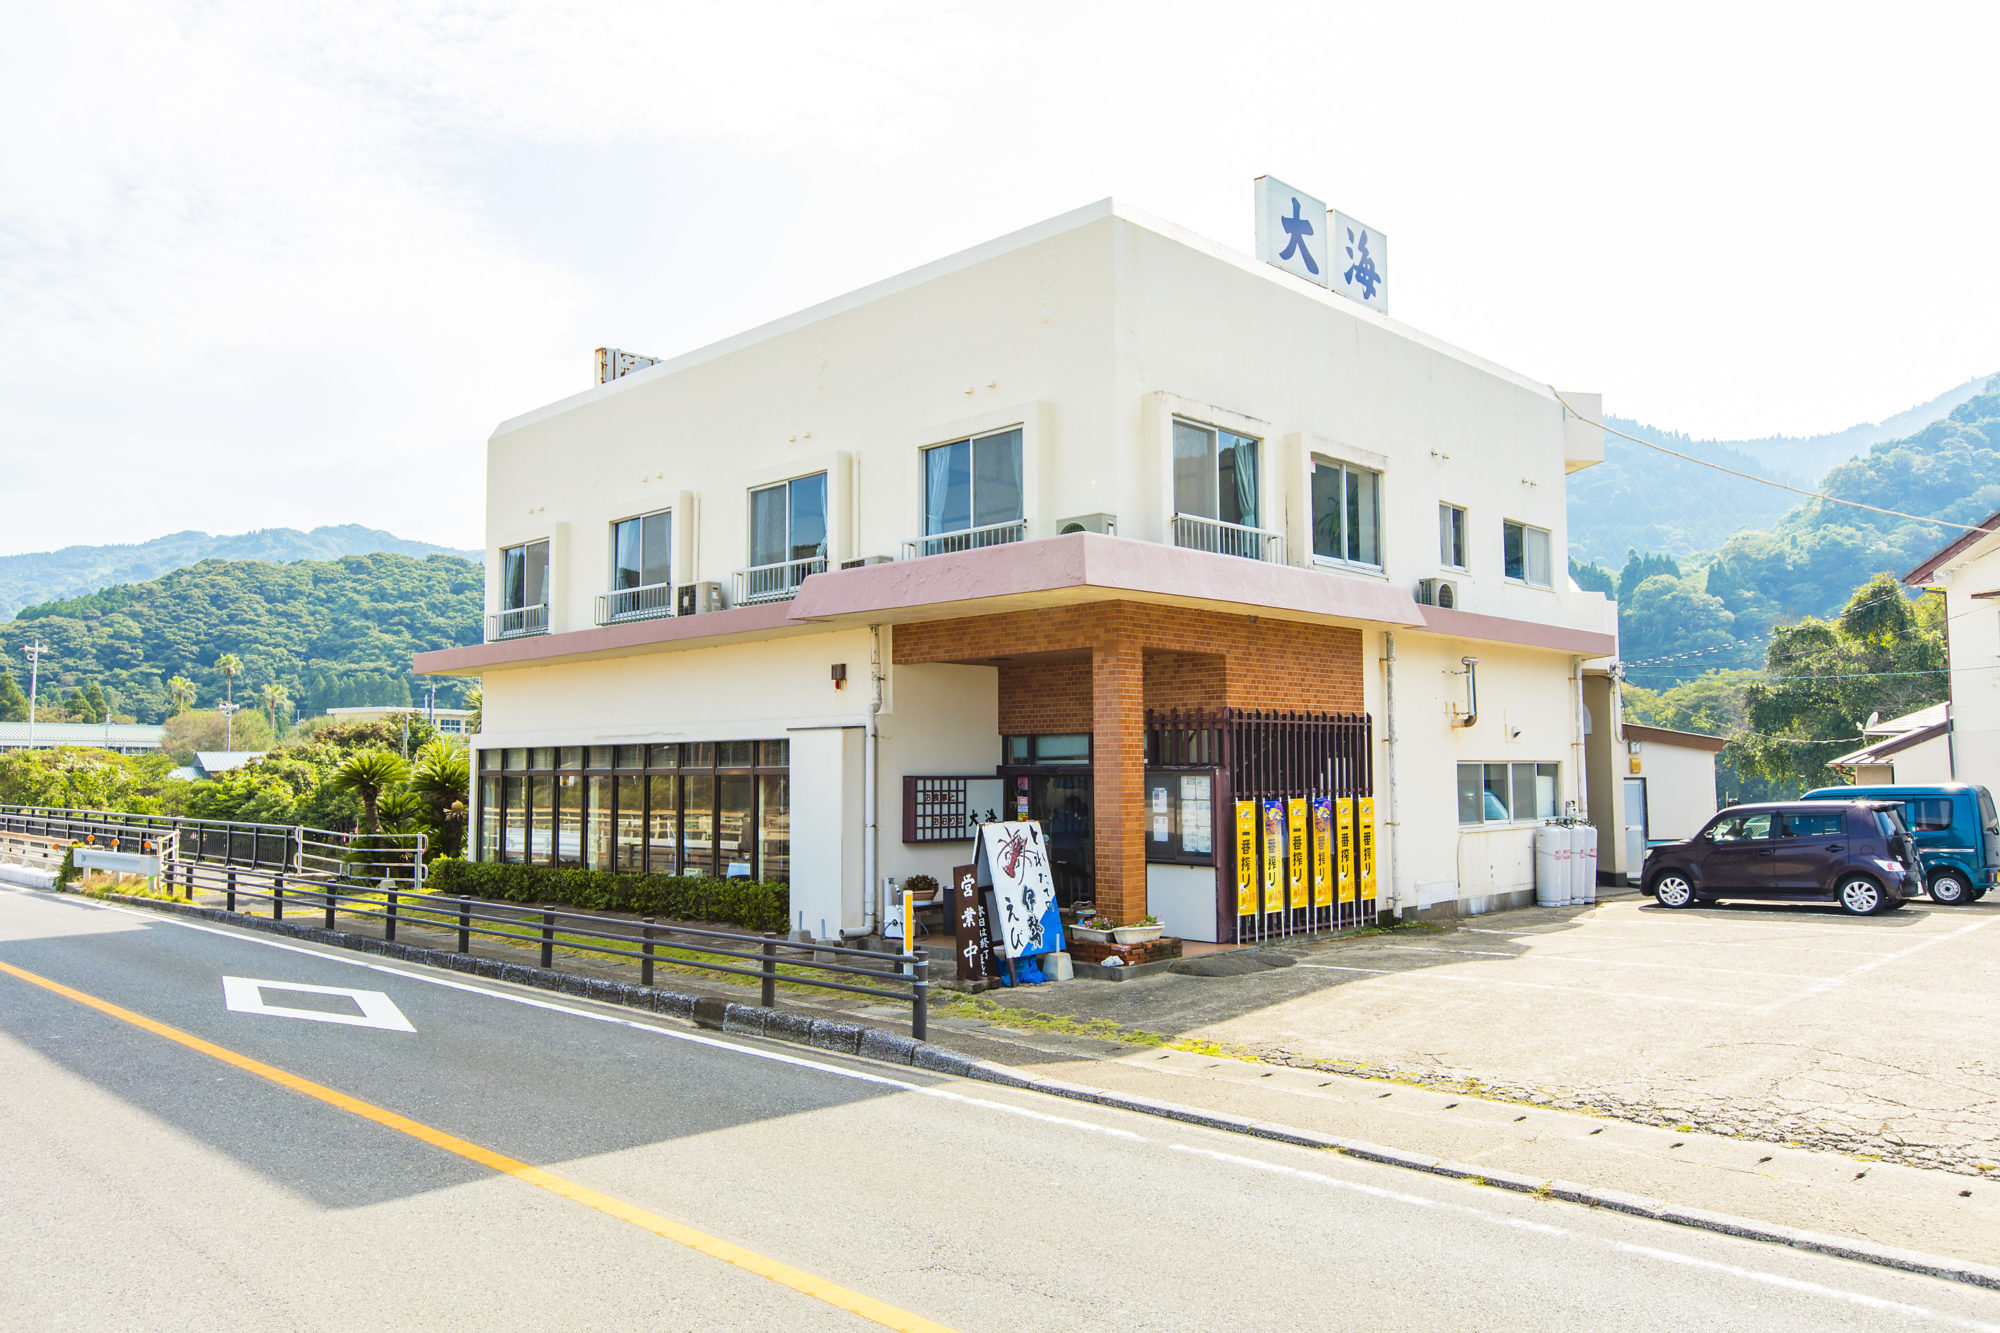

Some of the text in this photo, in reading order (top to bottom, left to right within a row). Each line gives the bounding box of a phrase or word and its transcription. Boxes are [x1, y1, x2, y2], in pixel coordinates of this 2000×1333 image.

[1279, 197, 1381, 300] 大海
[1029, 824, 1055, 913] とれたての
[1241, 831, 1251, 889] 一番搾り
[1267, 838, 1277, 887] 番搾り
[1293, 828, 1303, 882] 一番搾り
[1317, 835, 1326, 882] 番搾り
[1341, 825, 1350, 878] 一番搾り
[1363, 824, 1372, 875] 一番搾り
[961, 873, 979, 969] 営業中
[1005, 896, 1024, 951] えび
[1022, 884, 1044, 951] 伊勢
